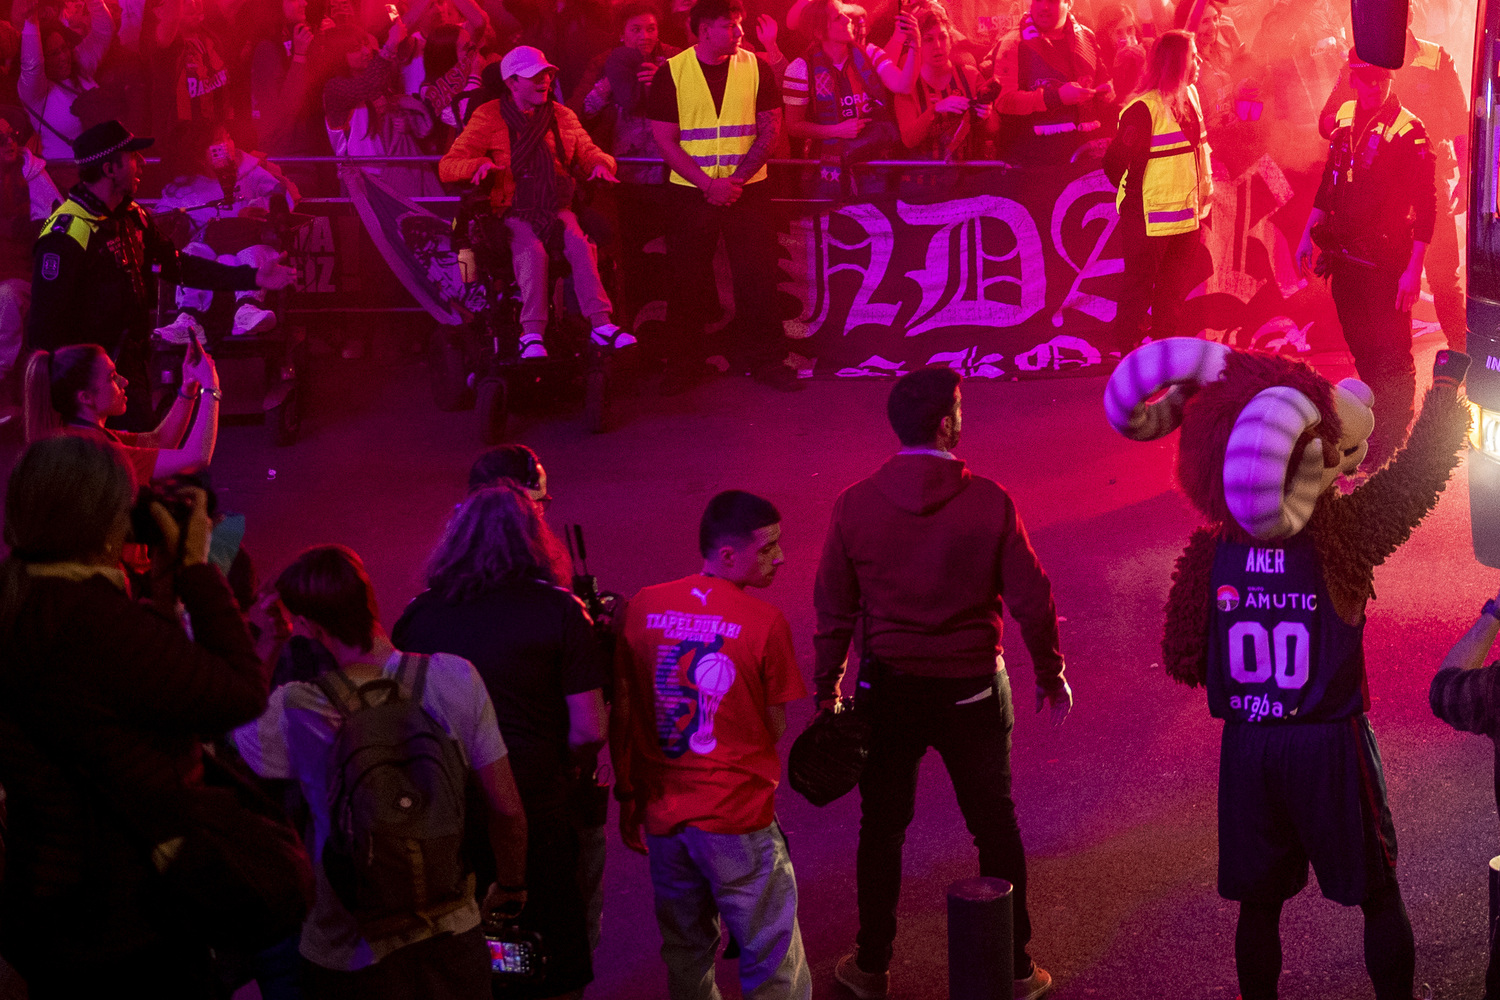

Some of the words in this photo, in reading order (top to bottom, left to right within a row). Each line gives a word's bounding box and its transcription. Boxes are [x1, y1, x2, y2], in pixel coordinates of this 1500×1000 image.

[1245, 547, 1285, 574] AKER
[1228, 621, 1310, 690] 00
[1229, 693, 1284, 718] araba
